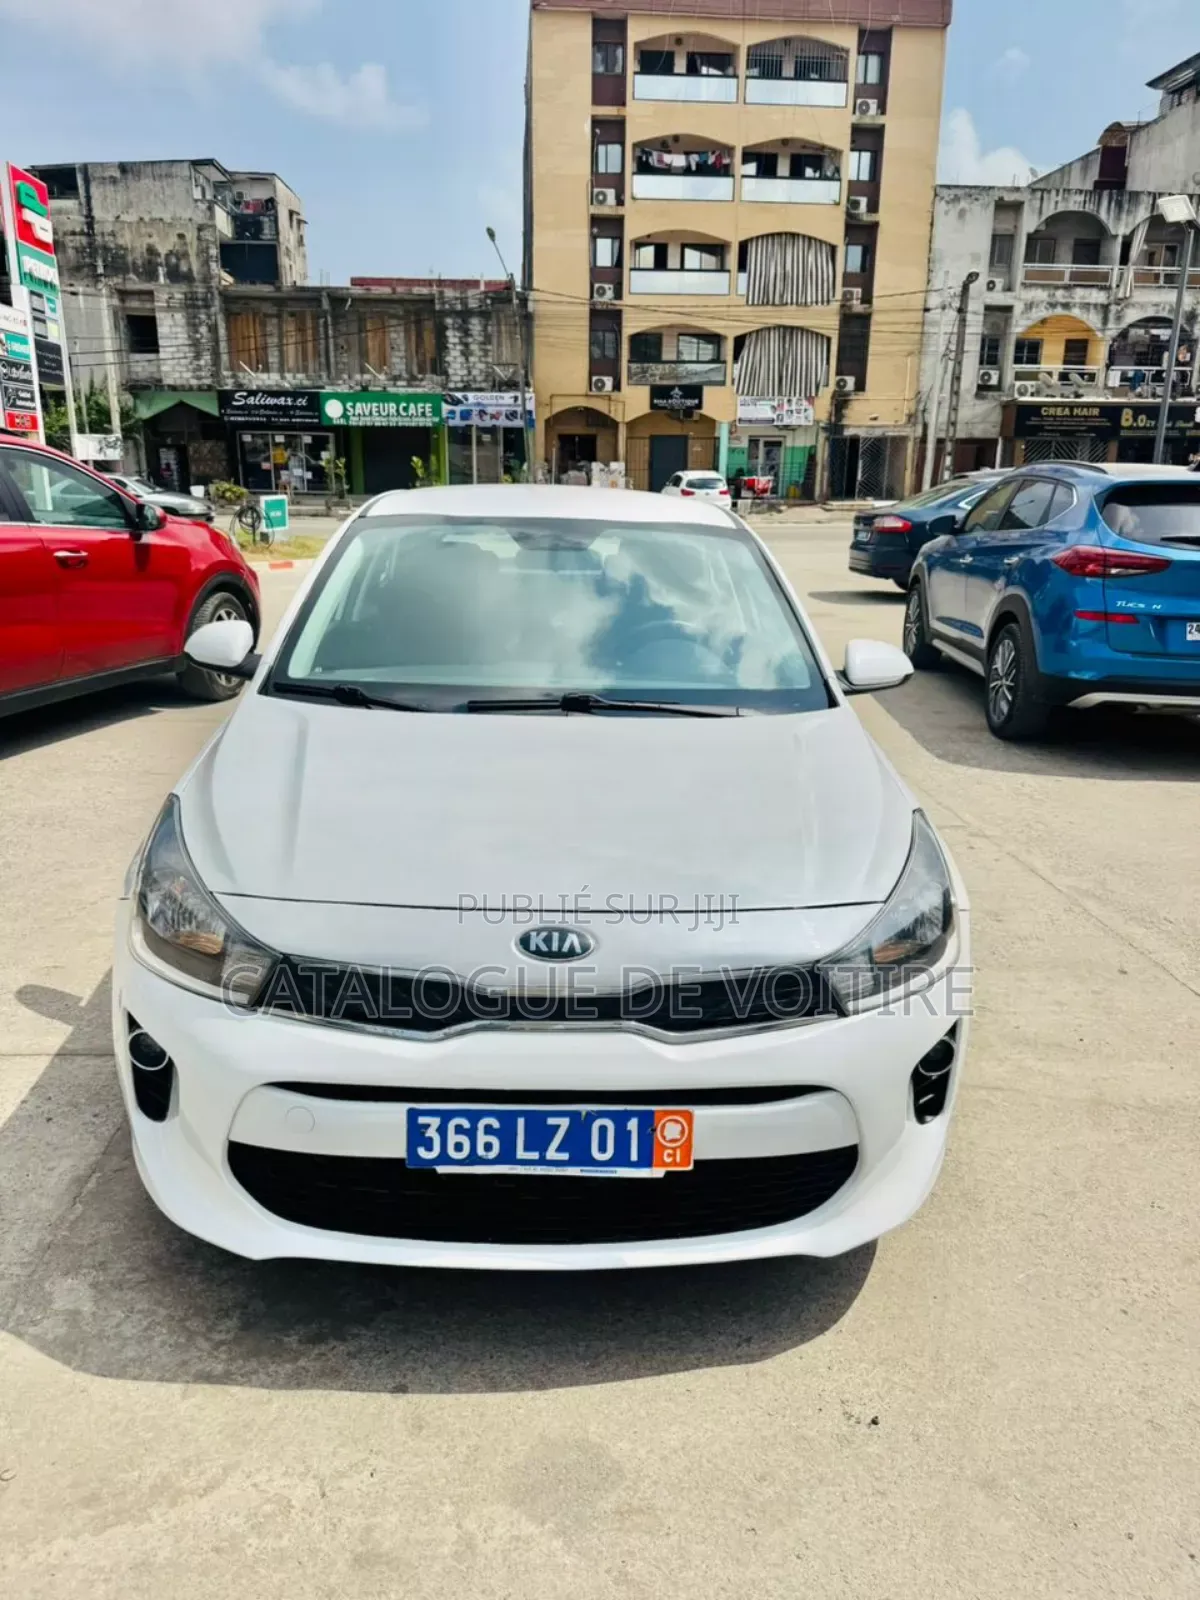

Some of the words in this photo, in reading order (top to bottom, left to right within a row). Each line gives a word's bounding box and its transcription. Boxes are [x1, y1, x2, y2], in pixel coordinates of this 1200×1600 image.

[231, 391, 309, 406] Saliwax.ci
[345, 402, 397, 416] SAVEUR
[399, 402, 433, 417] CAFE
[1041, 407, 1070, 416] CREA
[1073, 407, 1100, 416] HAIR
[529, 931, 582, 954] KIA
[417, 1116, 501, 1160] 366
[516, 1117, 571, 1160] LZ
[591, 1117, 639, 1162] 01
[662, 1149, 681, 1163] CI
